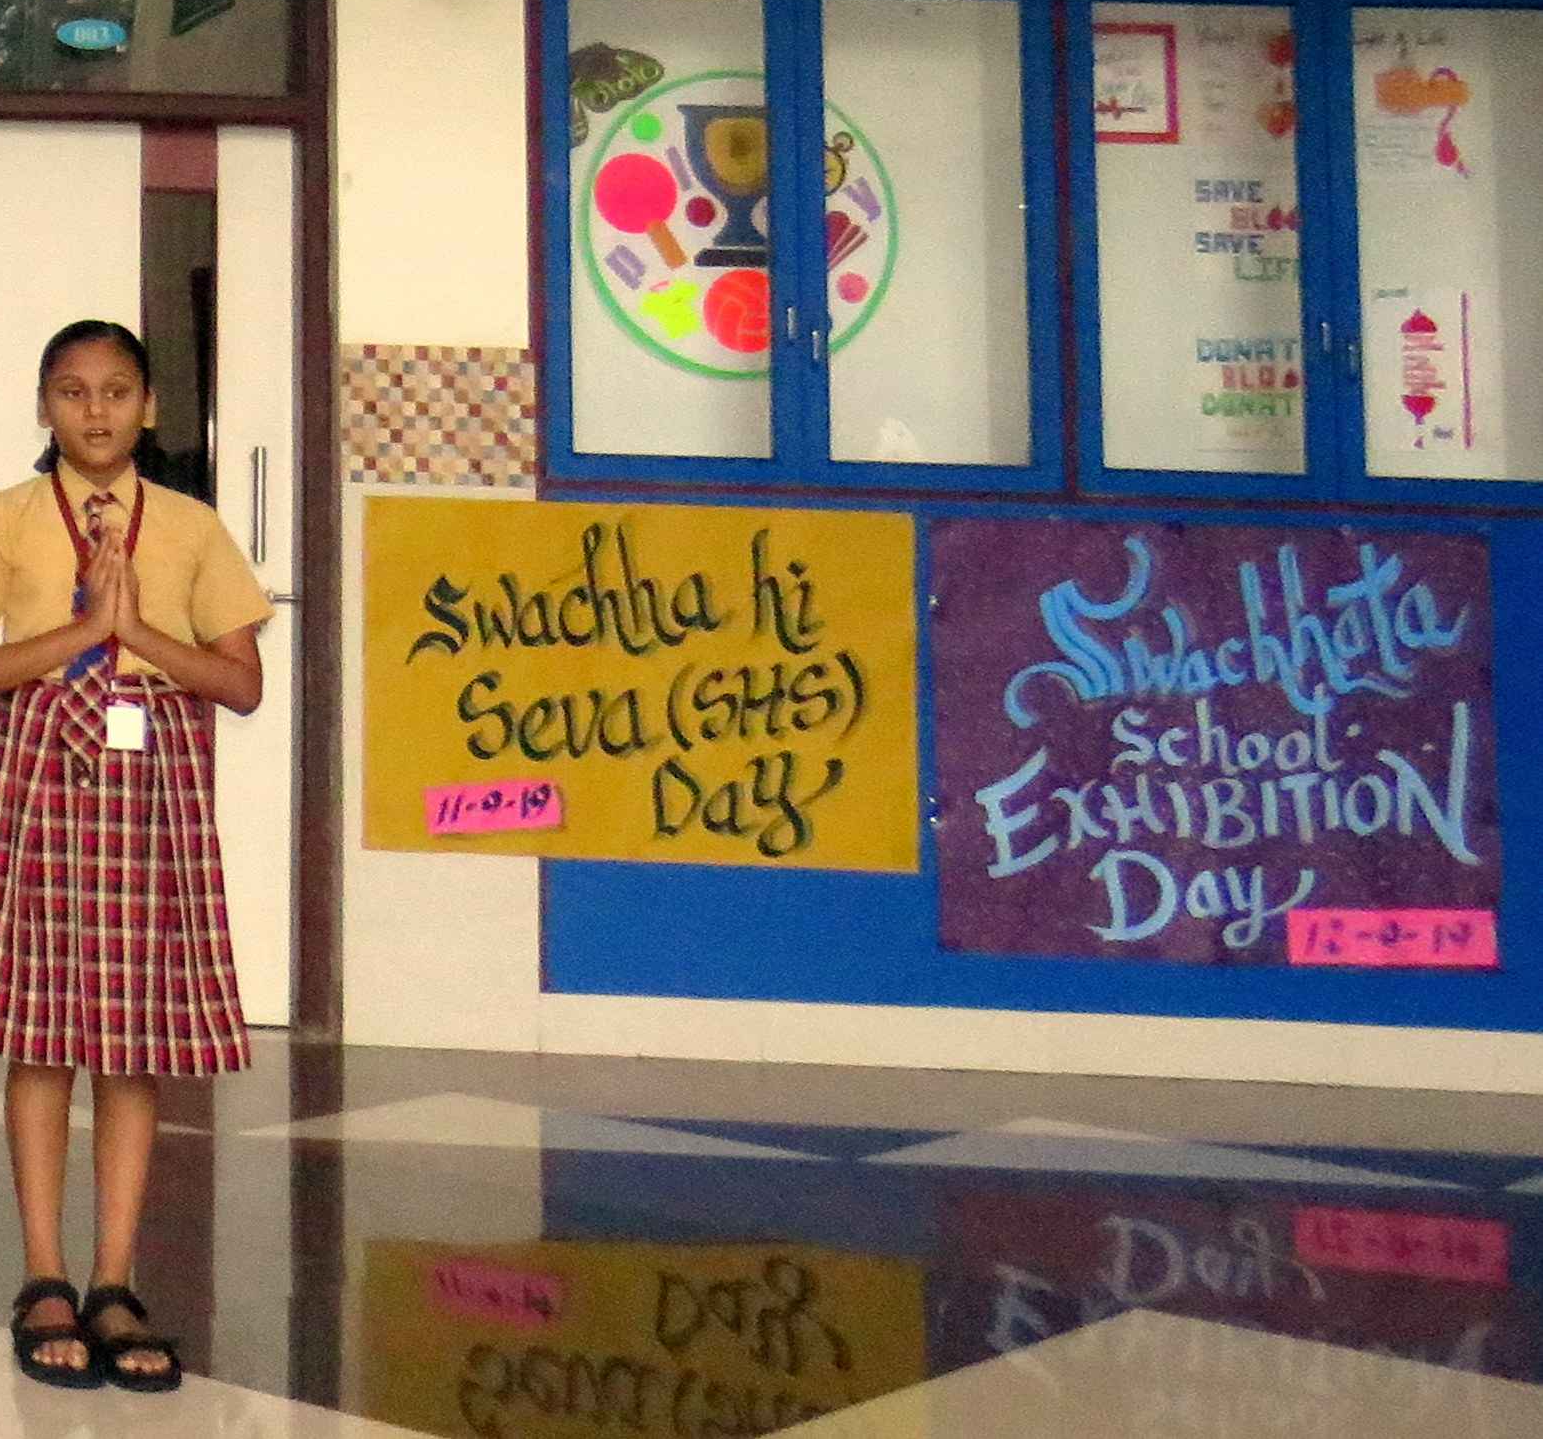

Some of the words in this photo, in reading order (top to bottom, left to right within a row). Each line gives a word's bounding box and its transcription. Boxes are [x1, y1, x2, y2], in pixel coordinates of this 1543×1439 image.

[1196, 338, 1300, 362] DONAT
[405, 523, 733, 666] Swachha
[752, 528, 827, 655] hi
[1003, 537, 1469, 730] Swachhata
[457, 671, 658, 761] Seva
[667, 650, 867, 750] (SHS)
[1111, 698, 1344, 771] School
[653, 750, 844, 858] Day
[1087, 849, 1315, 949] Day
